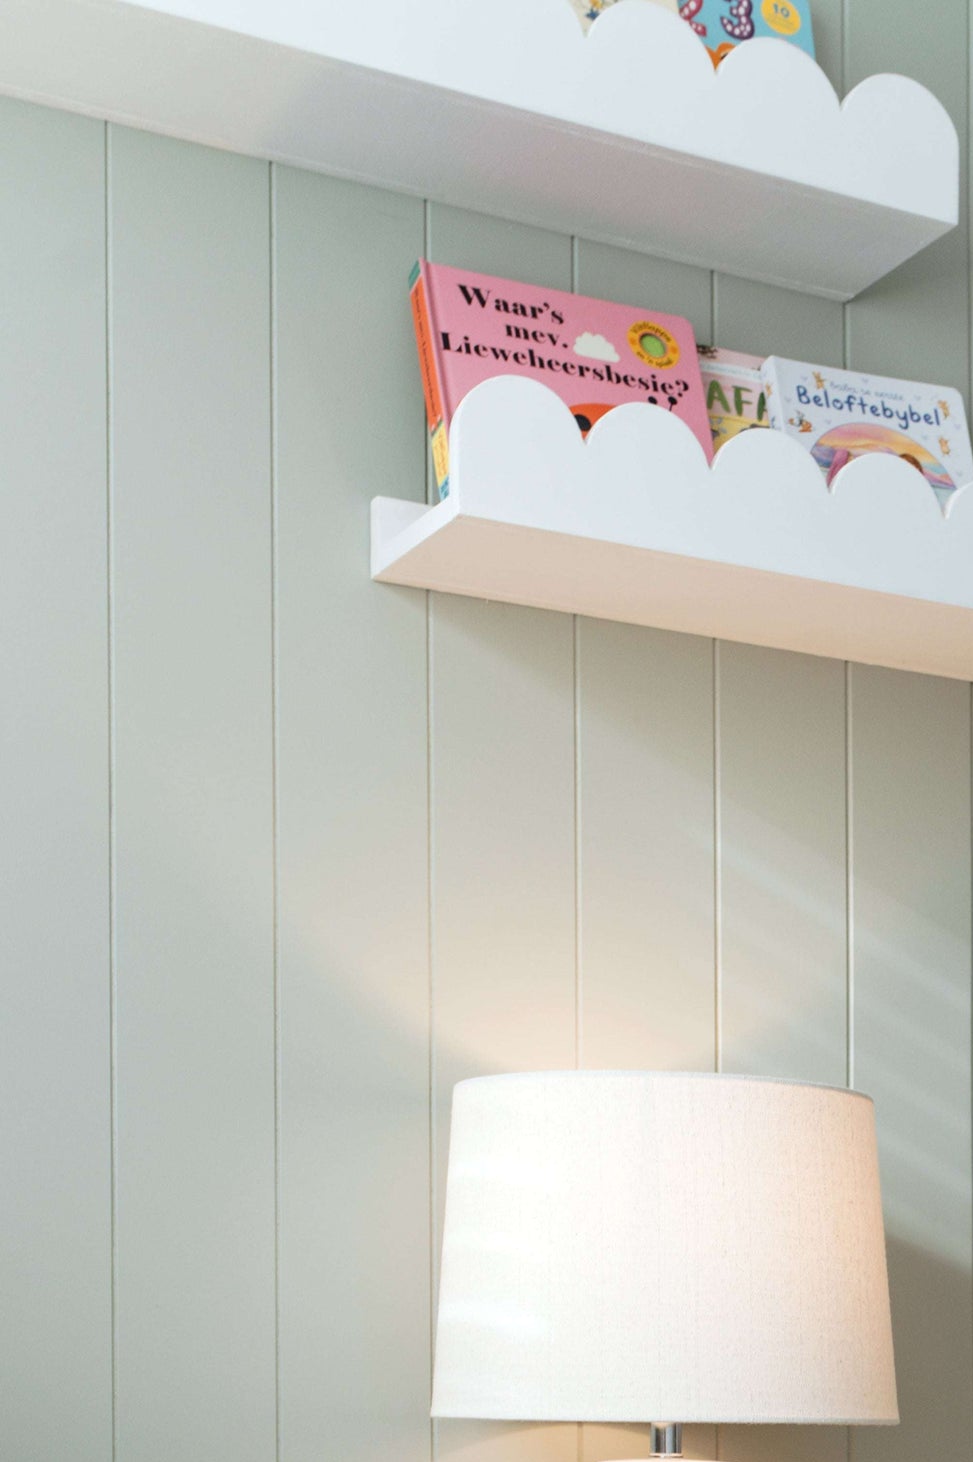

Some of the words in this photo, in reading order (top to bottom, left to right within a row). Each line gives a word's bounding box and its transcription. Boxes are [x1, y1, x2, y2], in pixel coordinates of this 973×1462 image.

[458, 284, 564, 325] Waar's
[505, 324, 569, 349] mev.
[441, 332, 689, 398] Lieweheersbesie?
[796, 385, 941, 430] Beloftebybel
